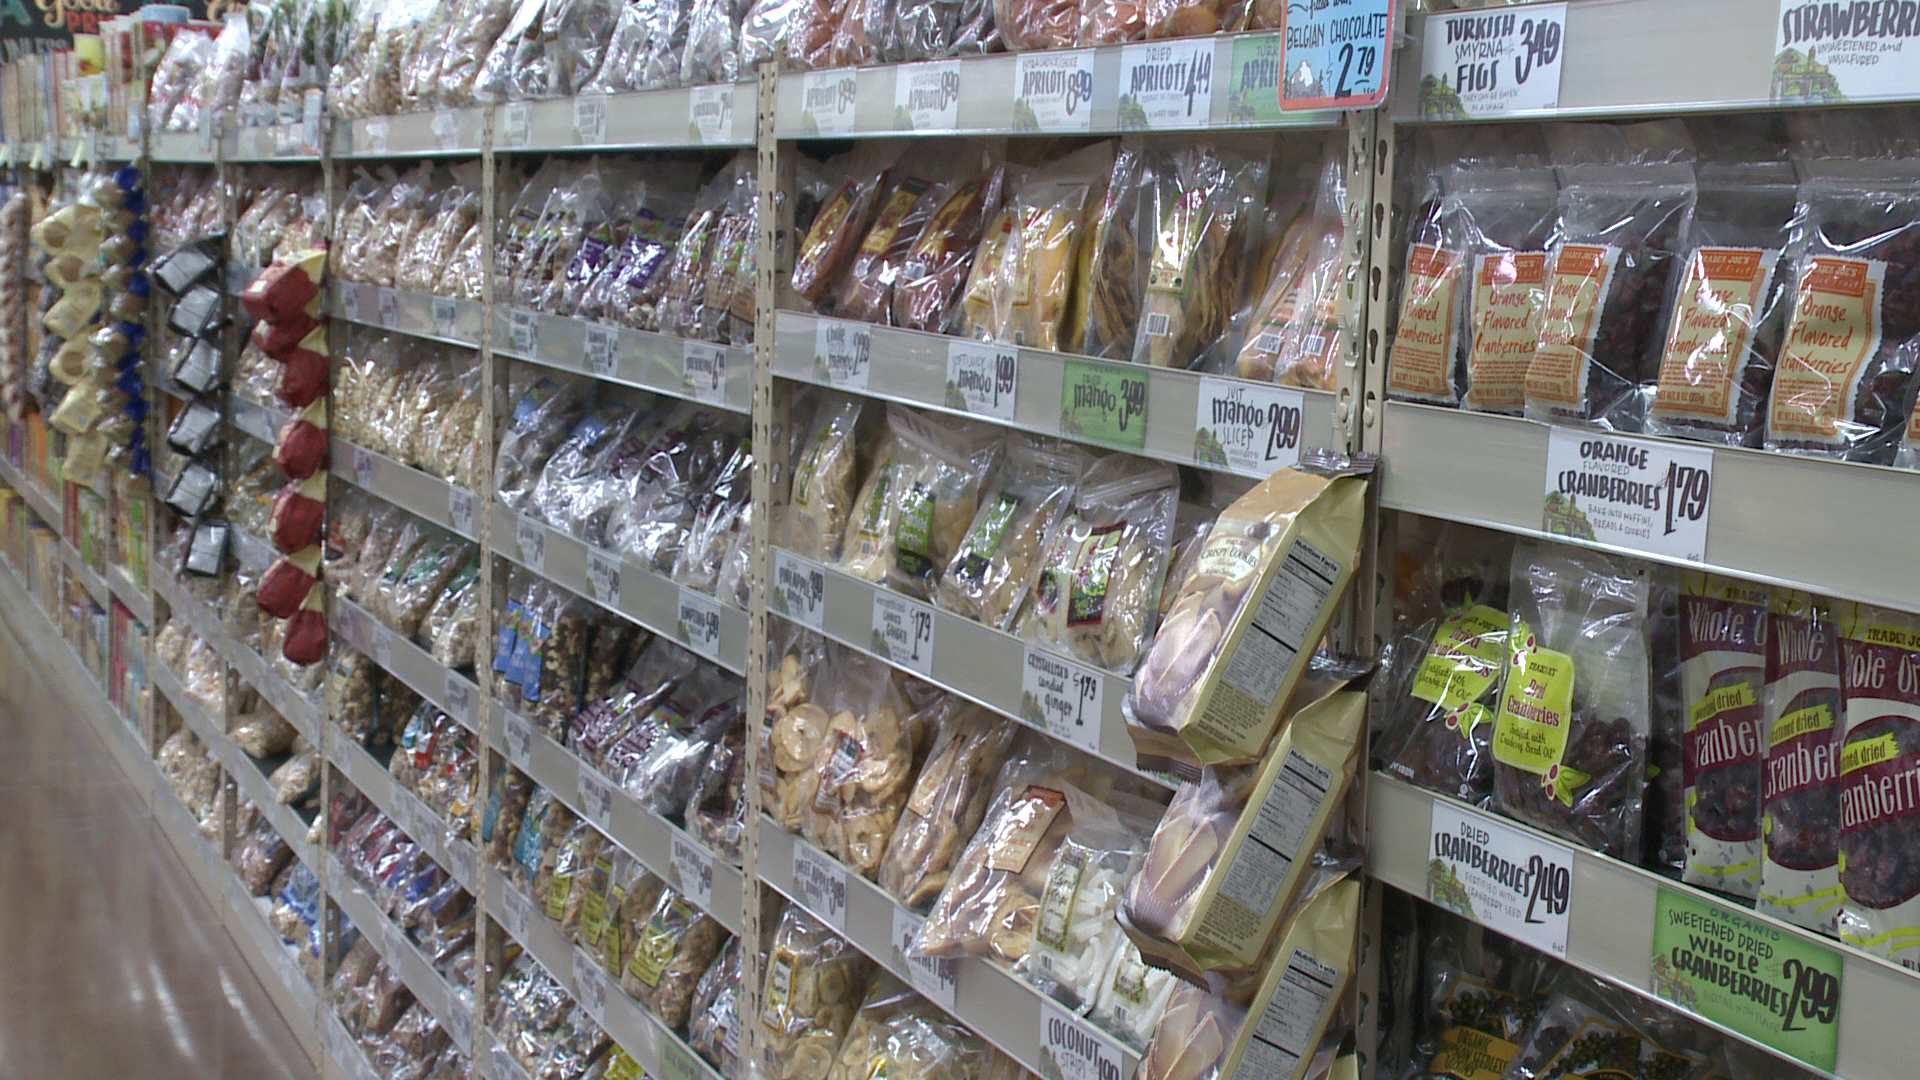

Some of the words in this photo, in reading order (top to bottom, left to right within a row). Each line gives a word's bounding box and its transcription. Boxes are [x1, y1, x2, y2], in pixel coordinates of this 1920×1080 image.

[1287, 24, 1325, 50] BELGIAN
[1330, 12, 1388, 44] CHOCOLATE
[1445, 14, 1516, 45] TURKISH
[1145, 46, 1172, 63] DRIED
[1455, 39, 1503, 64] SMYRNA
[1818, 40, 1878, 54] UNSWEETENED
[1880, 40, 1903, 53] and
[1828, 54, 1880, 67] UNSULFURED
[1021, 69, 1067, 98] APRICOTS
[1130, 62, 1186, 95] APRICOTS
[1456, 60, 1500, 95] FIGS
[1701, 254, 1727, 264] RADER
[1728, 255, 1751, 265] JOE'S
[1489, 286, 1527, 308] Orange
[1802, 293, 1847, 323] Orange
[1397, 320, 1443, 345] Cranberries
[1484, 308, 1531, 331] Flavored
[1475, 333, 1536, 356] Cranberries
[1791, 320, 1853, 351] Flavored
[1780, 345, 1852, 375] Cranberries
[959, 367, 992, 403] mango
[1226, 386, 1246, 402] JUST
[1074, 382, 1117, 422] mango
[1212, 396, 1264, 430] mango
[1579, 440, 1650, 470] ORANGE
[1582, 460, 1630, 476] FLAVORED
[1558, 469, 1663, 511] CRANBERRIES
[1588, 503, 1607, 516] BAKE
[1607, 508, 1623, 519] INTO
[1593, 518, 1618, 531] BREADS
[1624, 525, 1651, 539] COOKIES
[1201, 547, 1229, 560] CRISPY
[1229, 545, 1258, 568] COOKIES
[1295, 539, 1321, 560] Nutrition
[1321, 556, 1337, 572] Facts
[1687, 600, 1745, 645] Whole
[1867, 628, 1907, 646] TRADER
[1776, 619, 1826, 666] Whole
[1716, 689, 1743, 712] dried
[1796, 710, 1820, 735] dried
[1861, 740, 1887, 764] dried
[1460, 821, 1490, 846] DRIED
[1434, 832, 1531, 898] CRANBERRIES
[1465, 871, 1498, 896] FORTIFIED
[1499, 891, 1517, 905] WITH
[1467, 887, 1503, 913] CRANBERRY
[1504, 903, 1523, 919] SEED
[1482, 908, 1494, 921] OIL
[1709, 906, 1782, 942] ORGANIC
[1668, 908, 1735, 943] SWEETENED
[1737, 934, 1774, 960] DRIED
[1671, 946, 1790, 1018] CRANBERRIES
[1048, 1017, 1102, 1068] COCONUT
[1060, 1050, 1087, 1080] STRIPS
